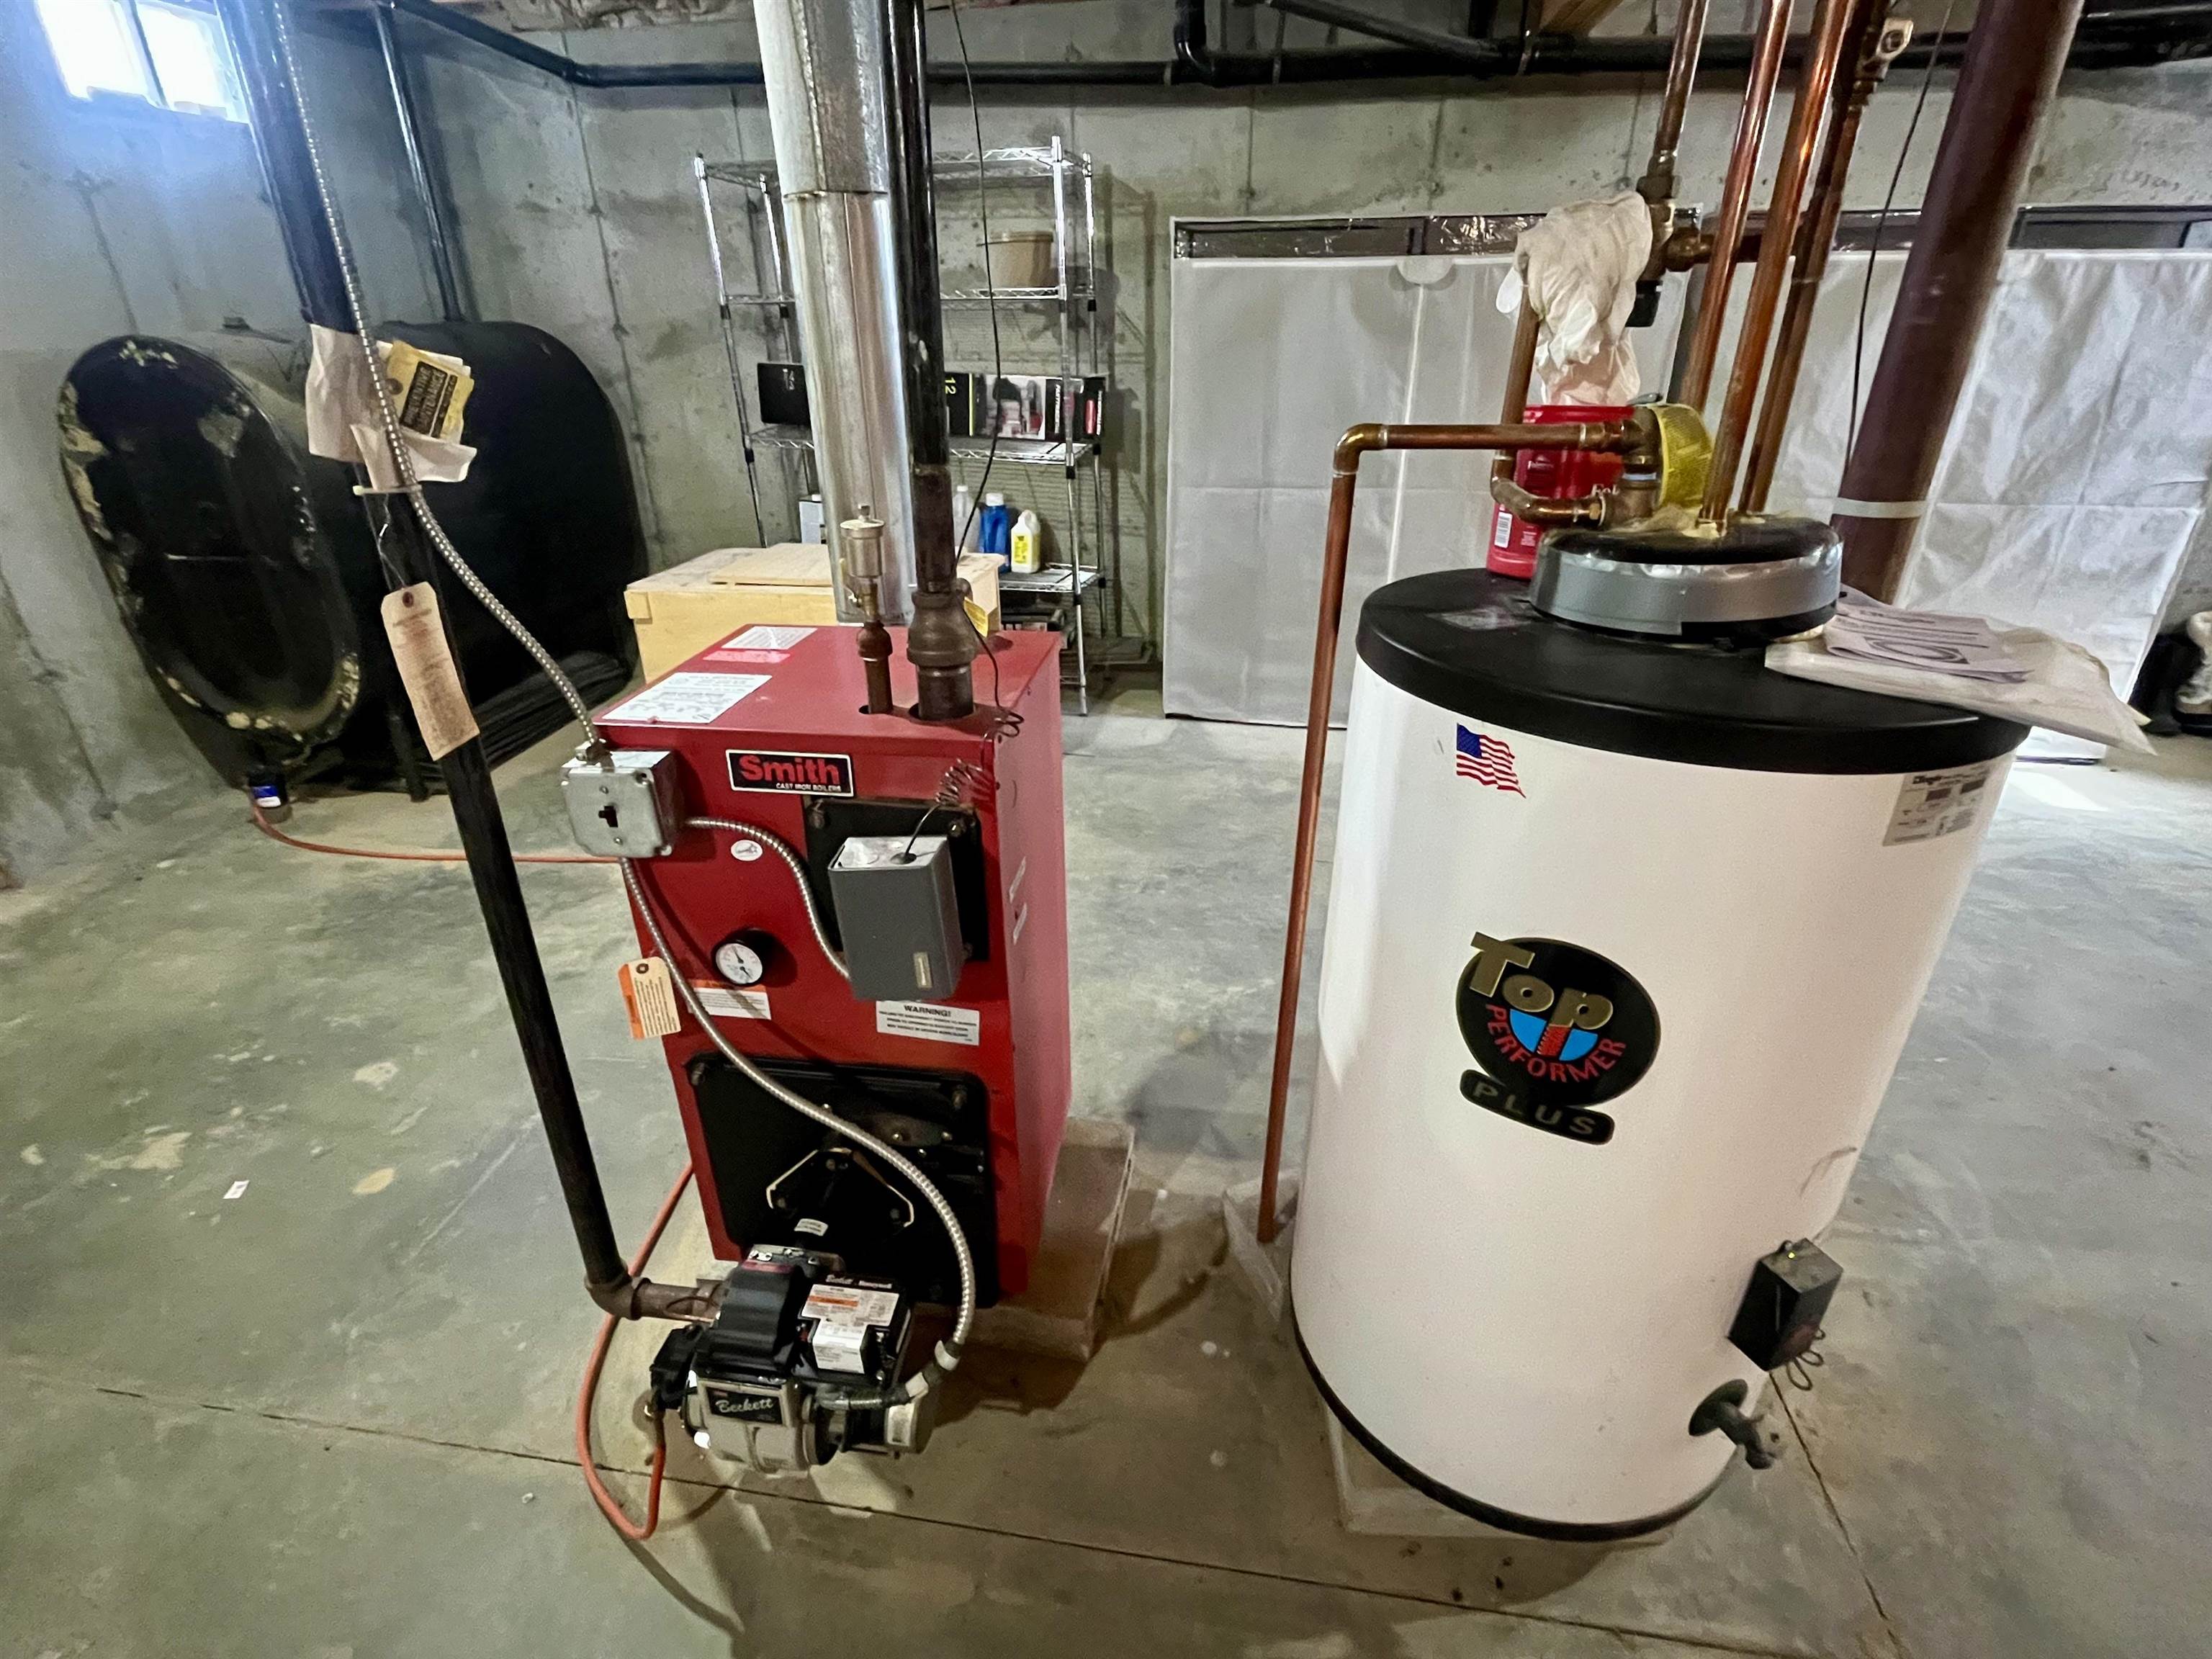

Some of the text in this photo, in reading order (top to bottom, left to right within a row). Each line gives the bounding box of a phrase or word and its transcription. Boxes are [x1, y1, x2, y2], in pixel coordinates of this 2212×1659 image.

[944, 377, 957, 395] 12
[739, 755, 840, 785] Smith
[1470, 931, 1614, 1030] Top
[904, 1005, 951, 1017] WARNING!
[1485, 1004, 1627, 1083] PERFORMER
[1473, 1082, 1596, 1135] PLUS
[715, 1398, 773, 1413] Beckett
